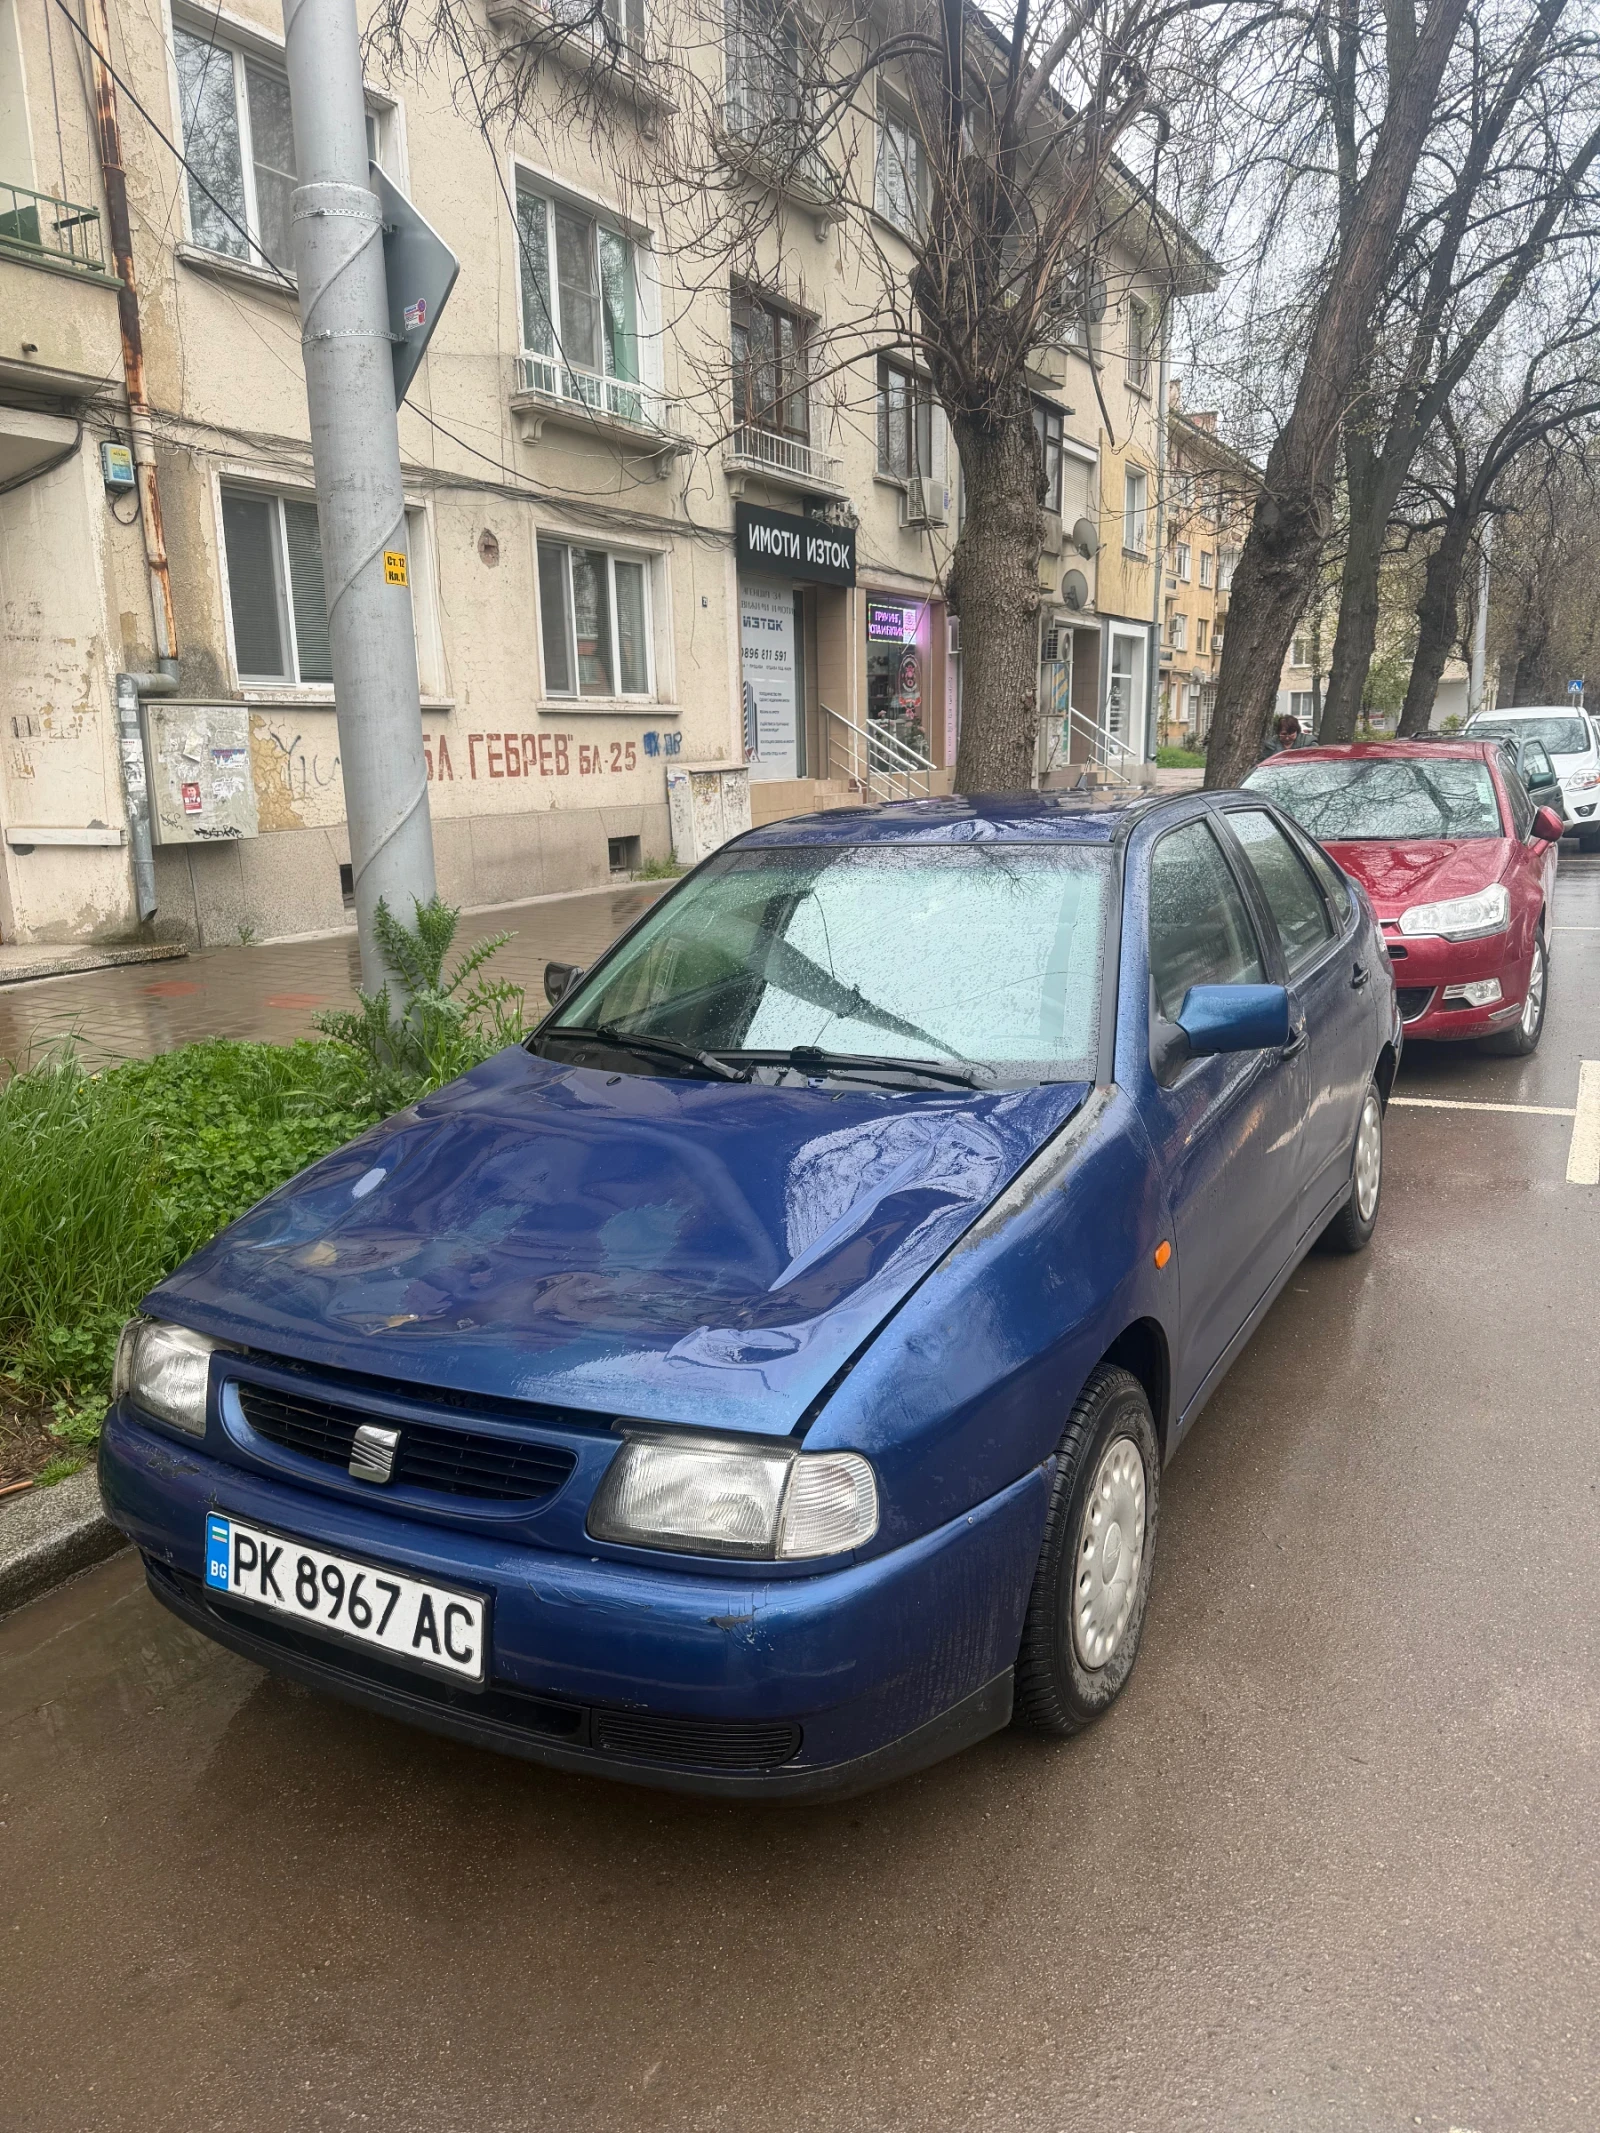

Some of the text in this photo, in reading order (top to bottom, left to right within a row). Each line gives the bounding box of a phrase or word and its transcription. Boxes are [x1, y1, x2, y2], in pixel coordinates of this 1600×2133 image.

[749, 523, 850, 570] ИМОТИ ИЗТОК
[742, 615, 783, 632] ИЗТОК
[210, 1531, 476, 1665] BG PK 8967 AC
